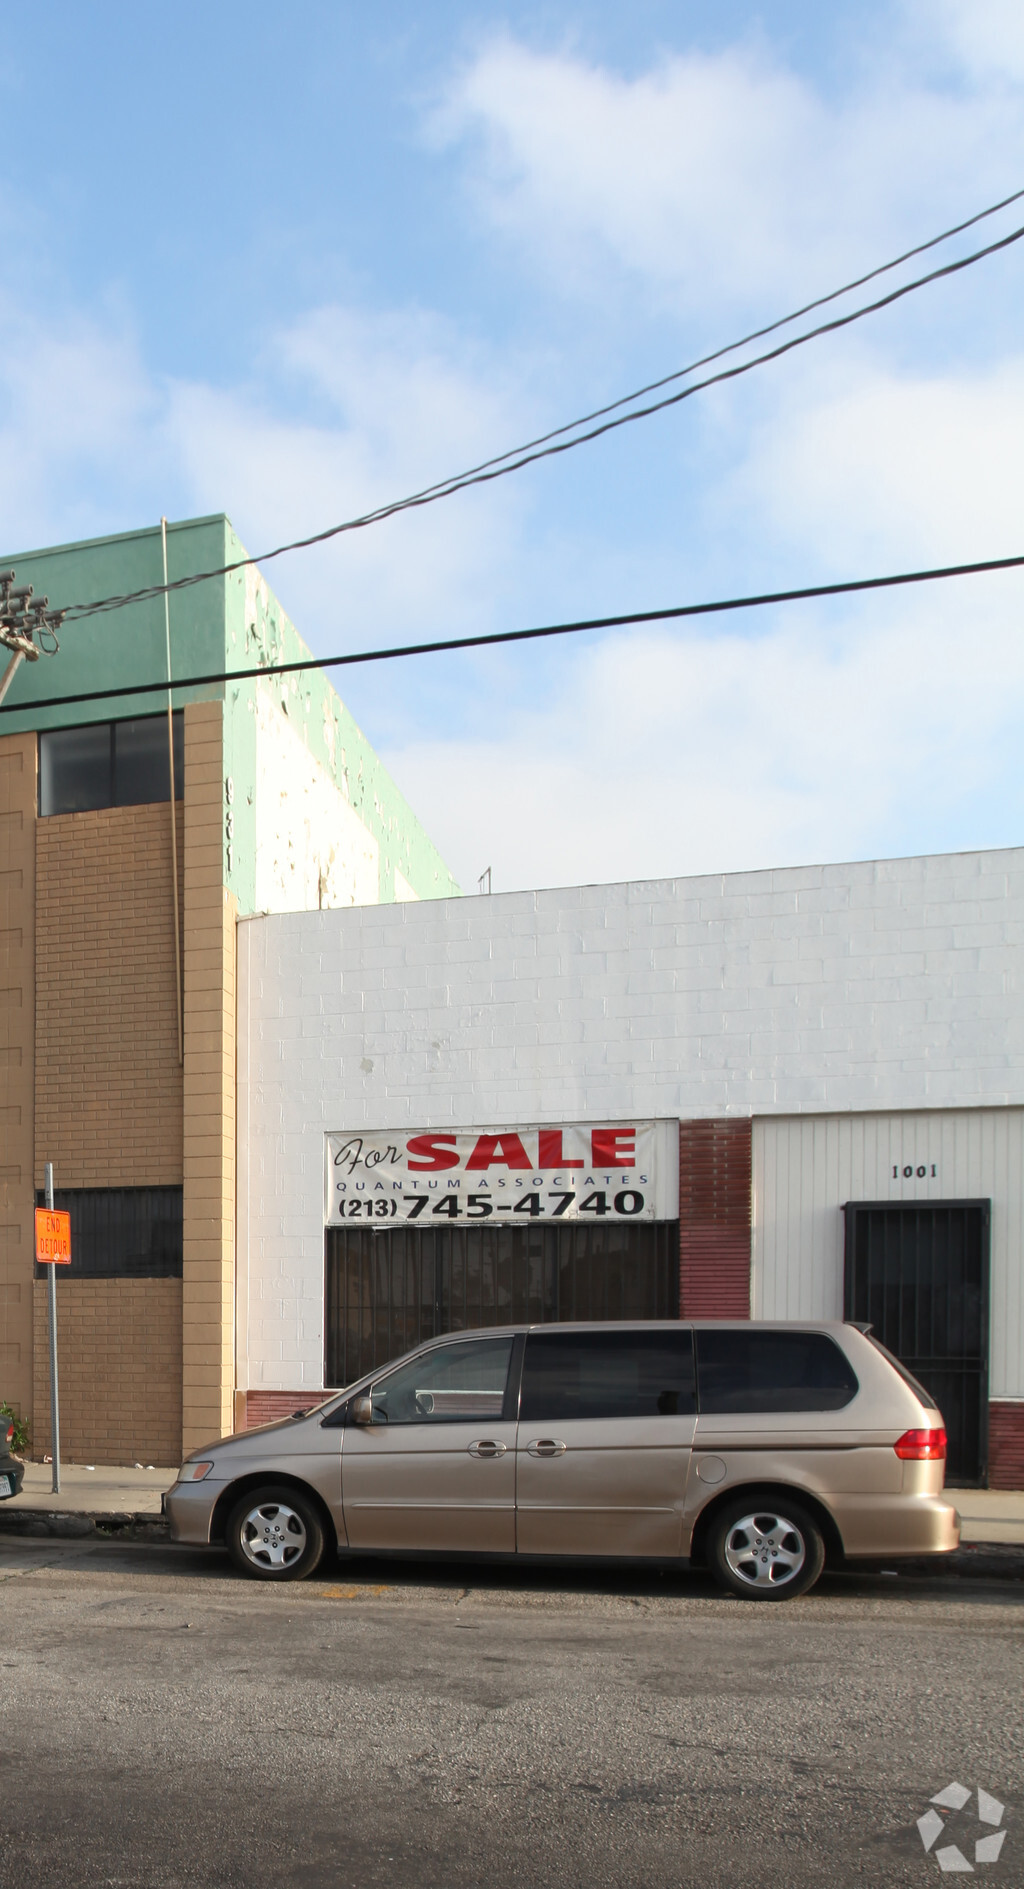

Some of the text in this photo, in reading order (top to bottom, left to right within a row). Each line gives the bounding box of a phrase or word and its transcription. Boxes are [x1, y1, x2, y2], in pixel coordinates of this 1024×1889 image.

[334, 1128, 636, 1175] For SALE
[892, 1163, 937, 1179] 1001
[336, 1174, 649, 1192] QUANTUM ASSOCIATES
[338, 1190, 644, 1219] (213) 745-4740
[46, 1216, 61, 1233] END
[40, 1238, 67, 1255] DETOUR
